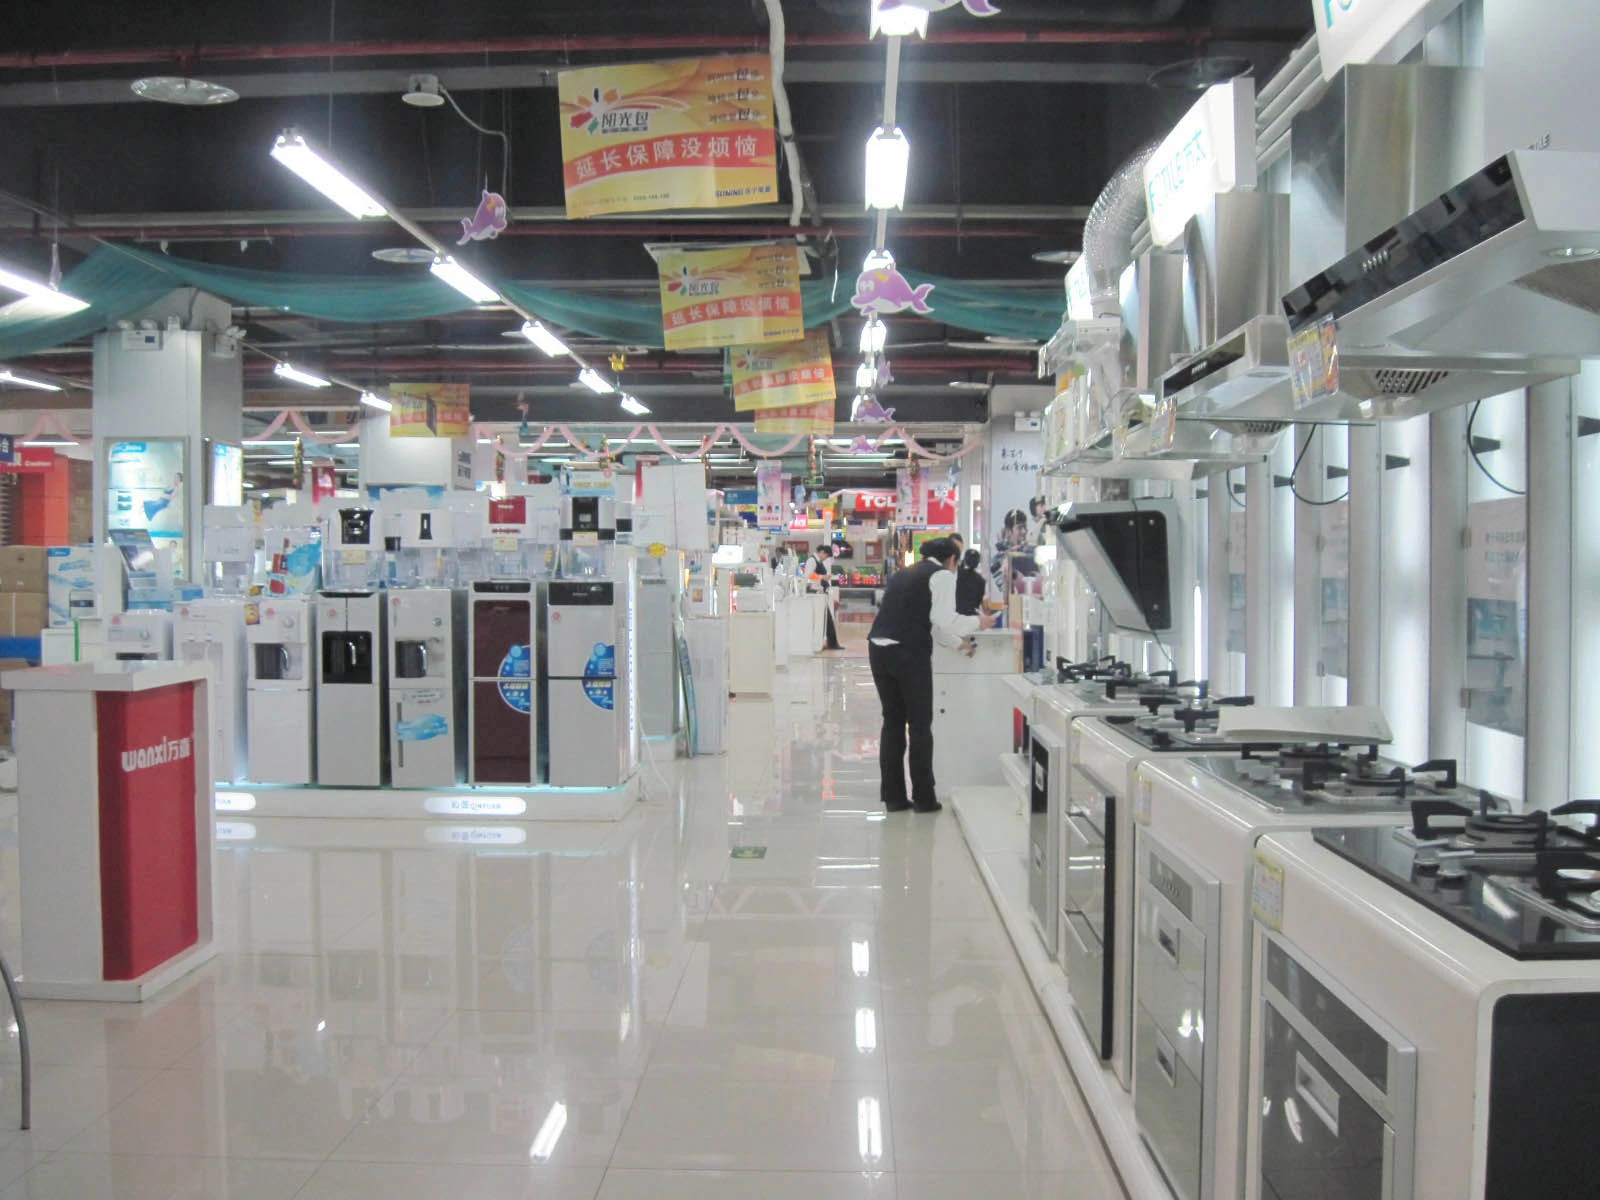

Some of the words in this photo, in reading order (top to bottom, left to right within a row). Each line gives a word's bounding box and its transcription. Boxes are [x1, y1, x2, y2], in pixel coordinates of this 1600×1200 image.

[574, 135, 758, 179] 延长保障没烦恼
[861, 495, 897, 507] TCL
[121, 735, 168, 773] wanxi
